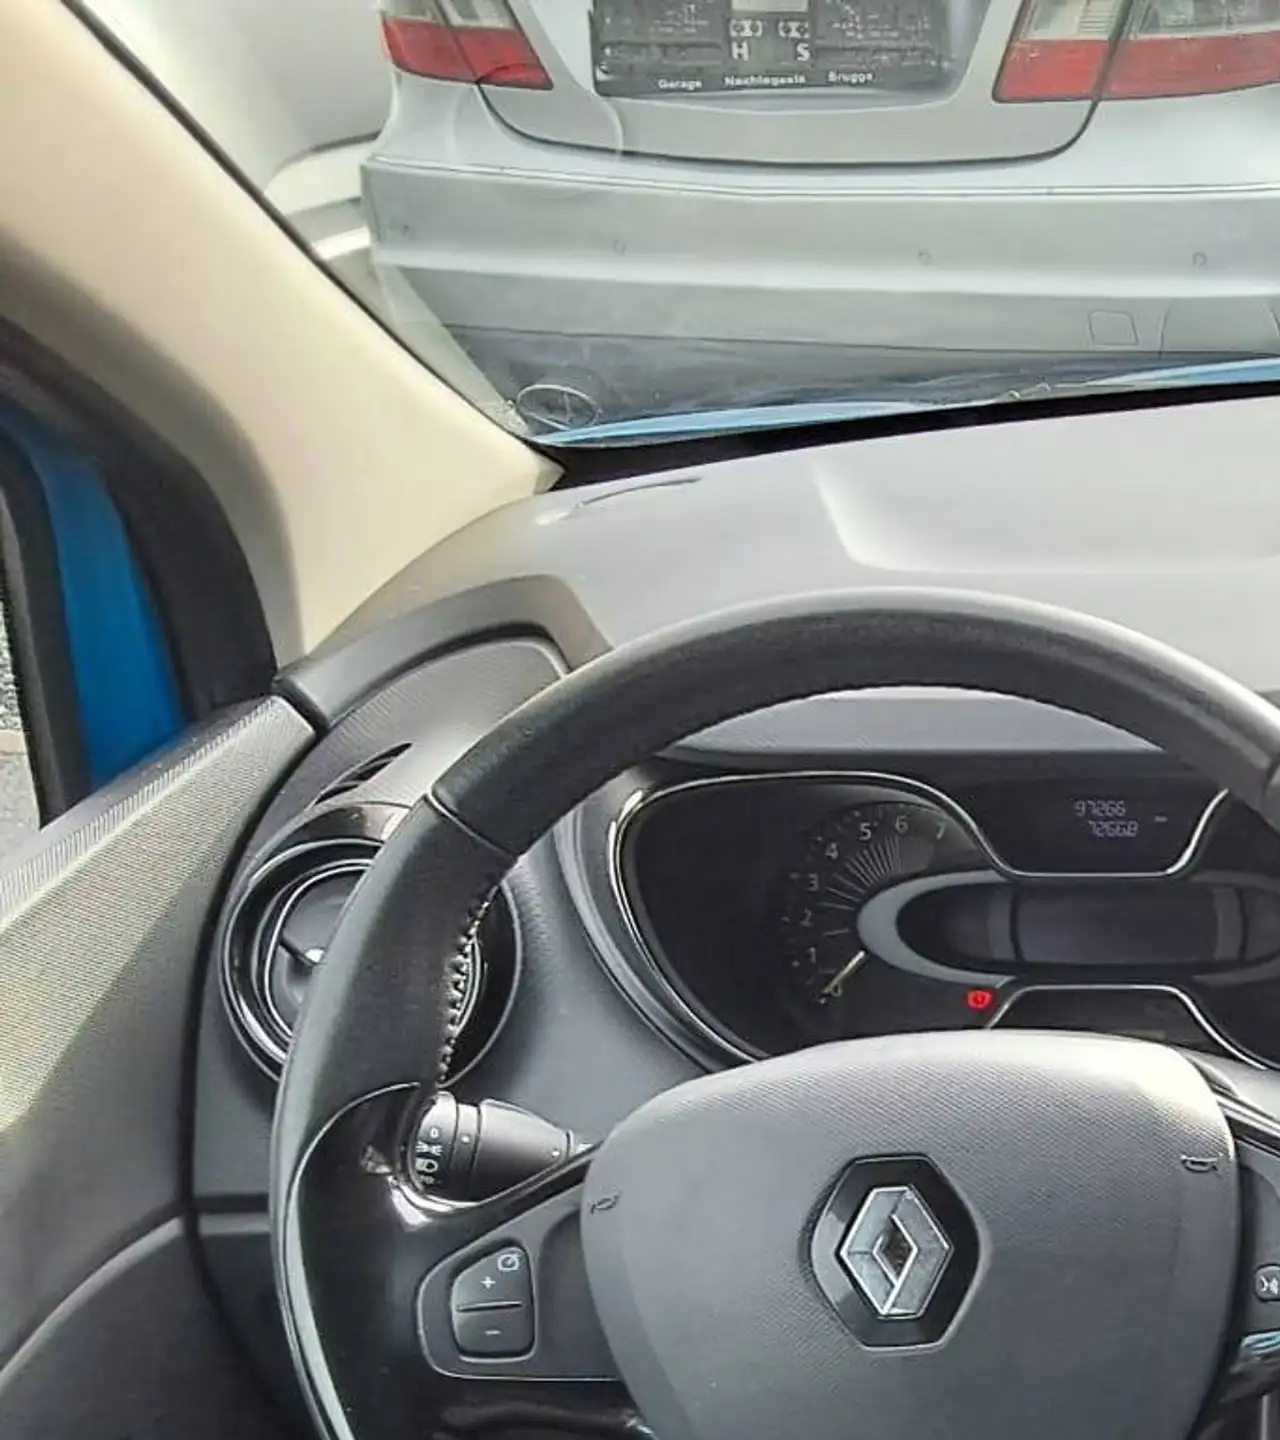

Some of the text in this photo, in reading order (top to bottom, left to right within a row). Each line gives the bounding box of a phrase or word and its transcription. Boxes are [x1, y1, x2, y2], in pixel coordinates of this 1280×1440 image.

[658, 78, 702, 91] Garage
[858, 822, 872, 840] 5
[894, 815, 908, 833] 6
[935, 822, 947, 840] 7
[825, 842, 838, 859] 4
[808, 873, 819, 891] 3
